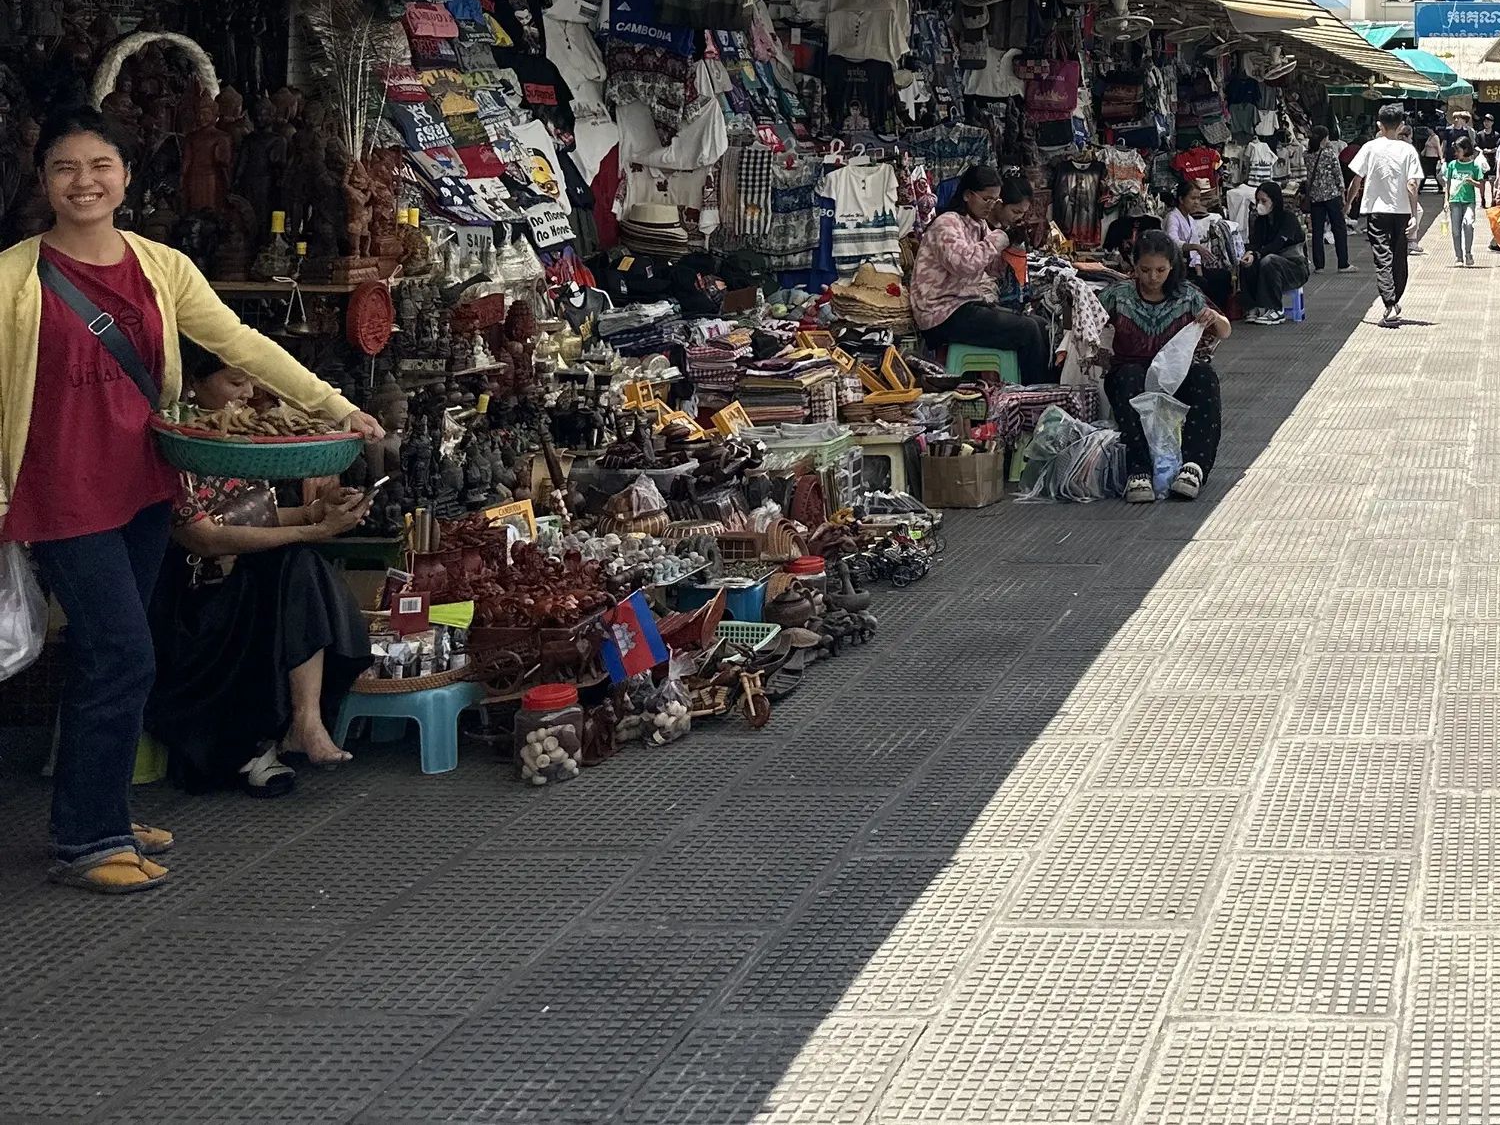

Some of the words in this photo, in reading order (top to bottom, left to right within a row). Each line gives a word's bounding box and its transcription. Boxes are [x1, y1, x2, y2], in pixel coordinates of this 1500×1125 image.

[615, 22, 672, 43] CAMBODIA
[543, 210, 566, 222] Mone
[549, 225, 571, 236] Hone
